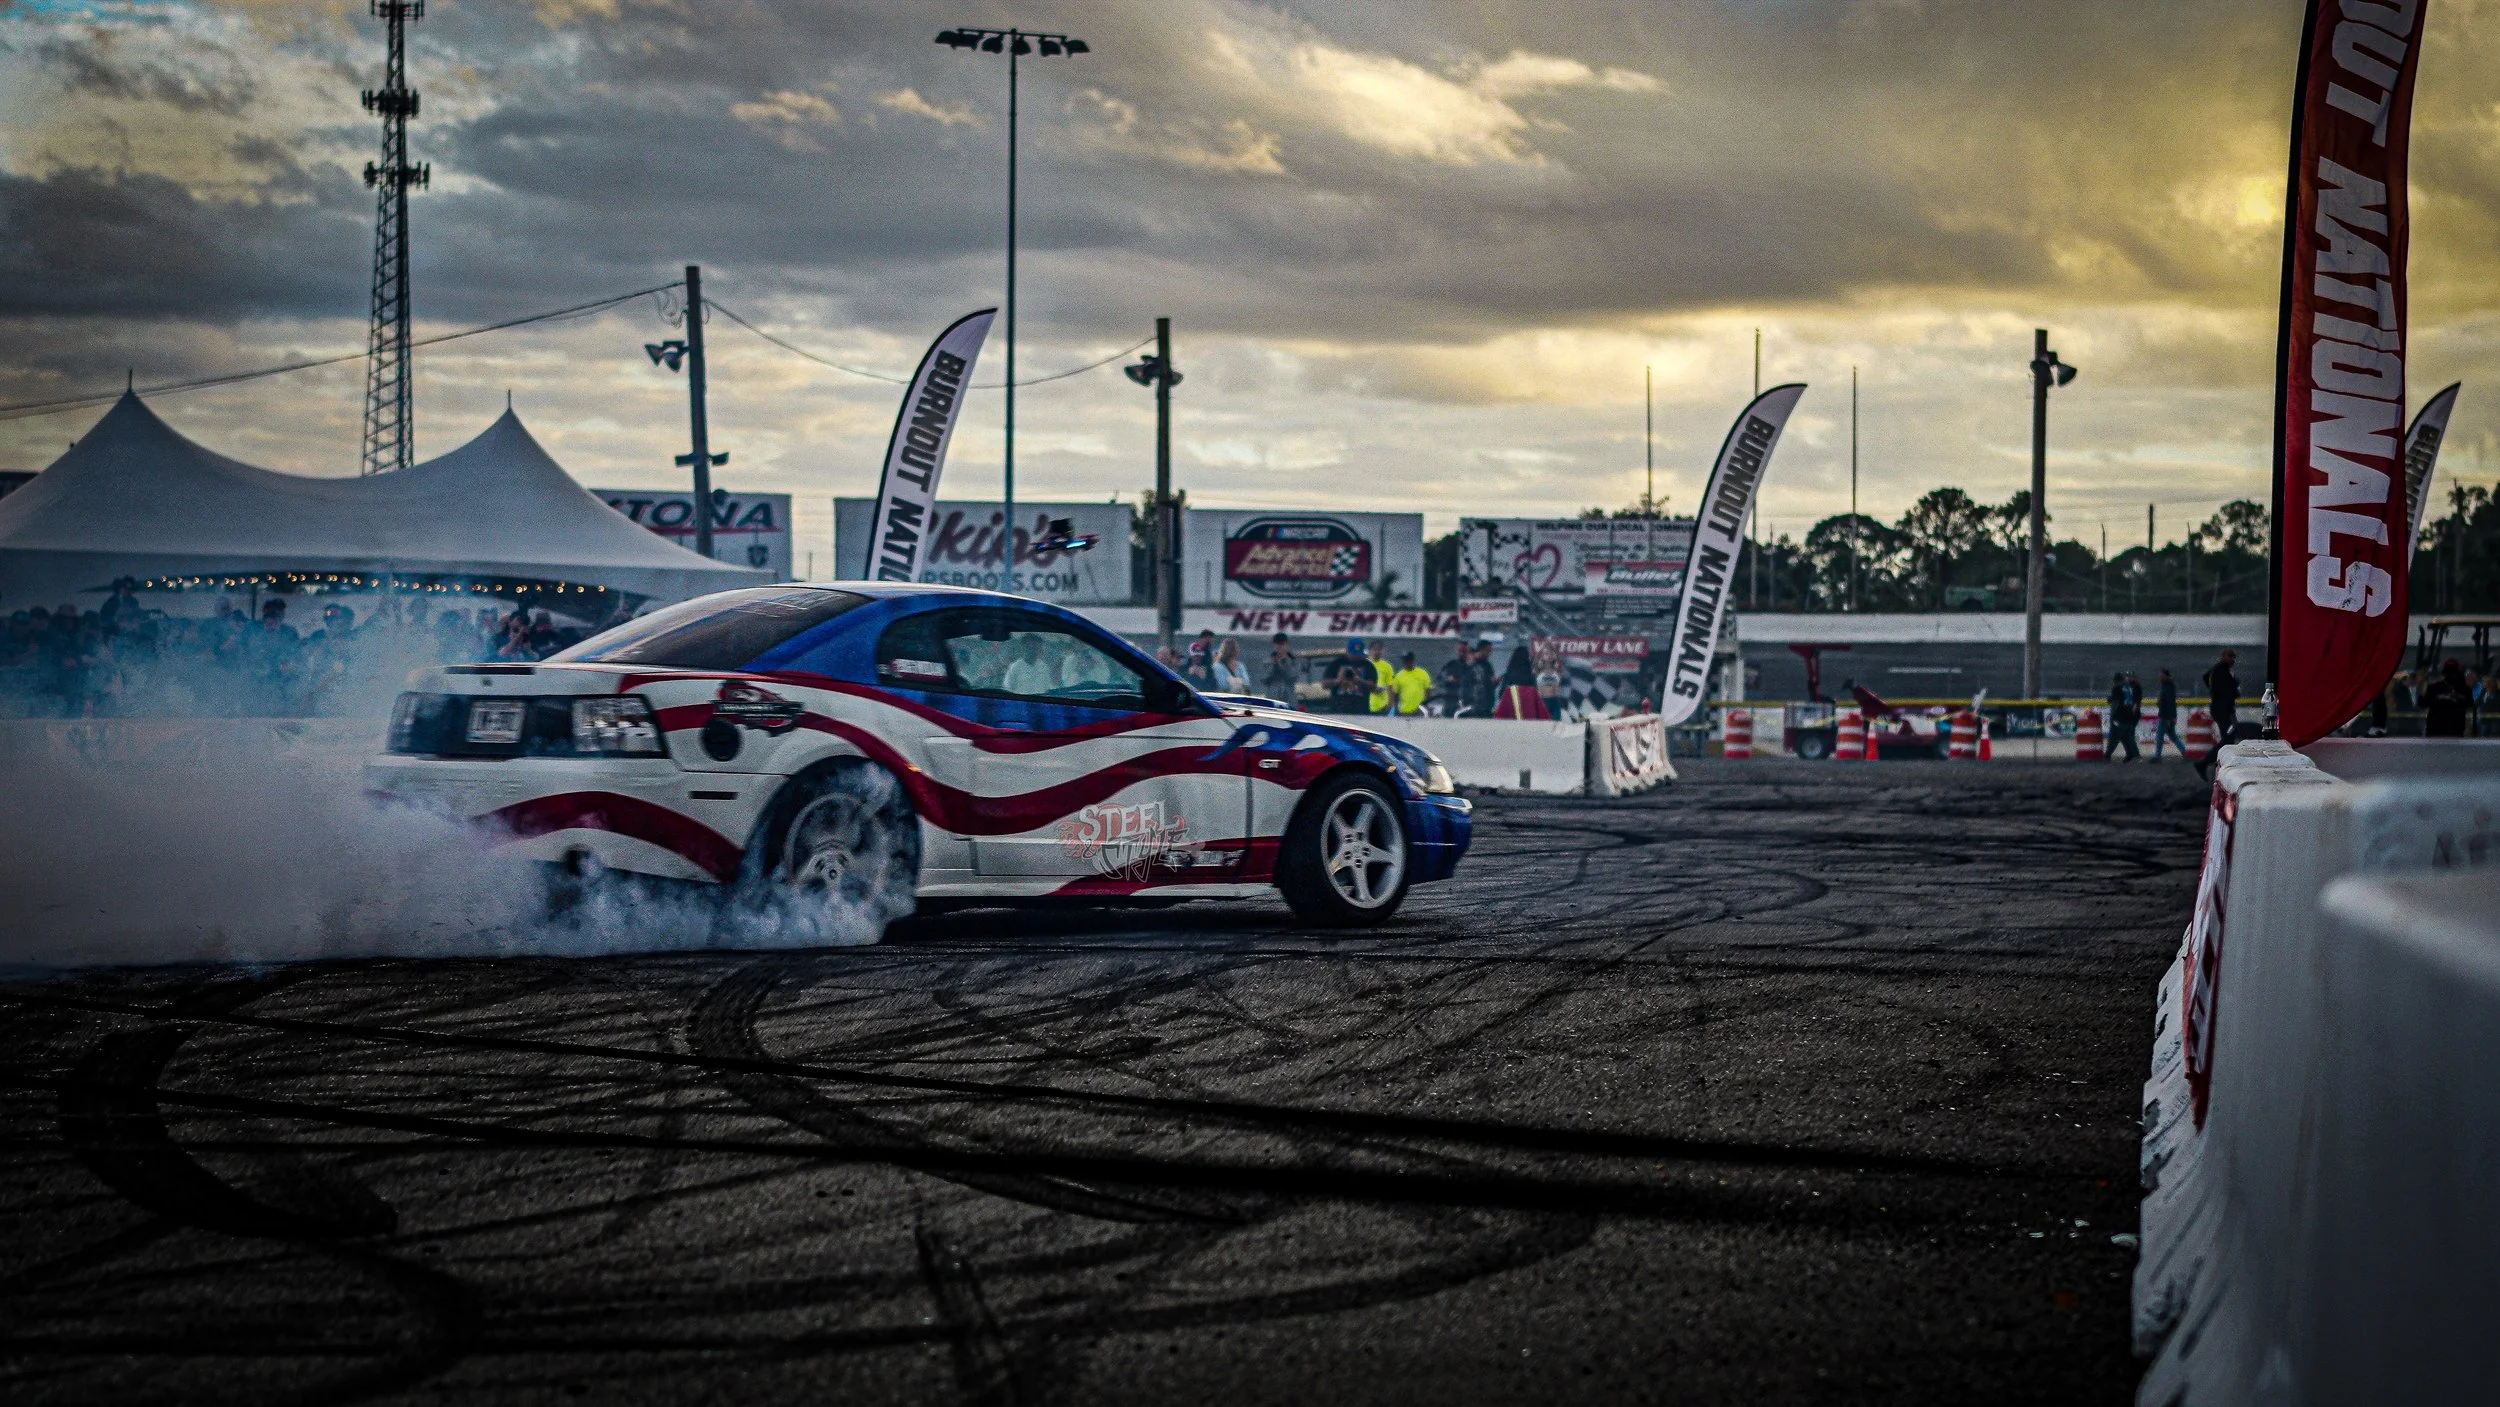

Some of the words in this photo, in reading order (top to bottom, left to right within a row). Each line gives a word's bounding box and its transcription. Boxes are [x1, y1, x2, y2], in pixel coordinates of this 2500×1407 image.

[897, 350, 967, 493] BURNOUT
[2306, 155, 2403, 617] NATIONALS
[1708, 415, 1776, 544] BURNOUT
[1228, 611, 1308, 631] NEW
[1326, 613, 1460, 635] SMYRNA
[1602, 641, 1644, 654] LANE
[1672, 544, 1731, 699] NATIONALS
